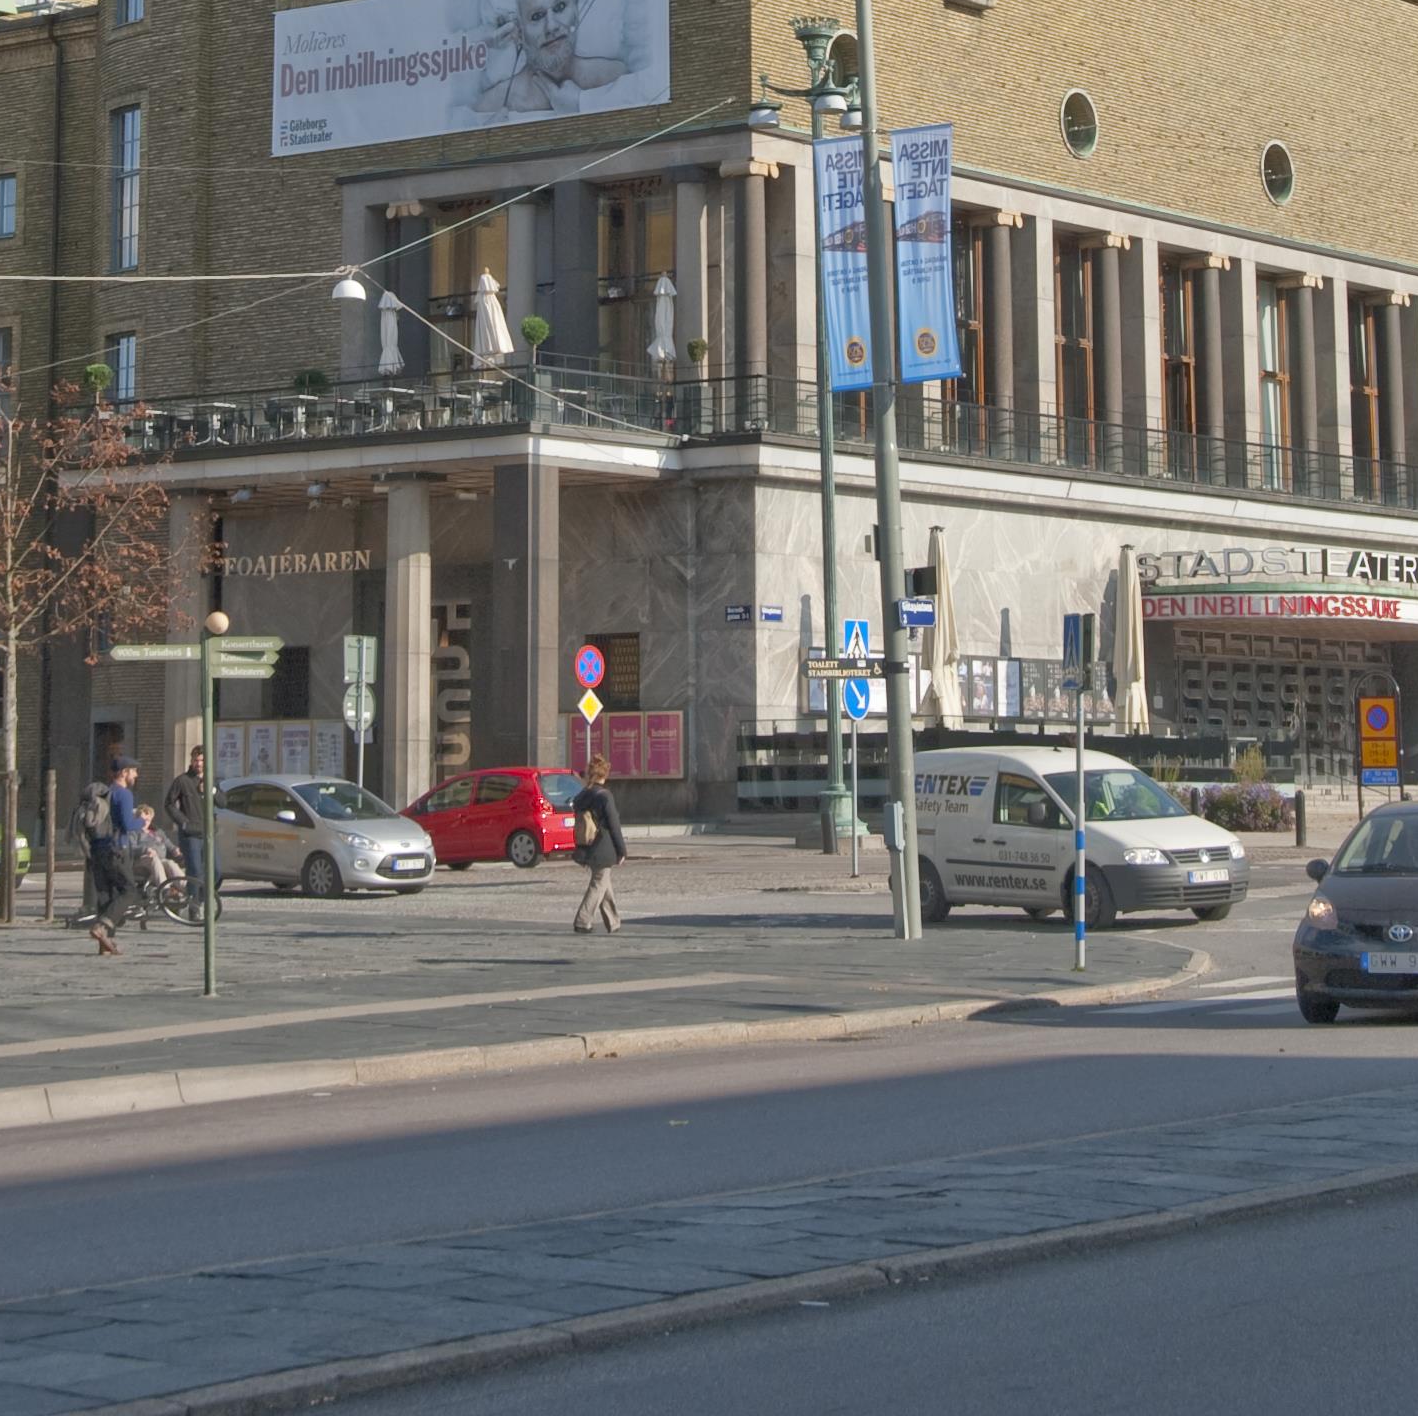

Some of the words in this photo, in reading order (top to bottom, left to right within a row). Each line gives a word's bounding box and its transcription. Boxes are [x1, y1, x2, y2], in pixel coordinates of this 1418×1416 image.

[283, 31, 347, 56] Molières
[281, 63, 319, 98] Den
[325, 36, 487, 92] inbillningssjuke
[289, 118, 328, 132] Göteborgs
[289, 131, 333, 146] Stadsteater
[223, 546, 372, 581] FOAJÉBAREN
[1142, 597, 1186, 618] DEN
[1194, 593, 1401, 620] INBILLNINGSSJUKE
[807, 661, 839, 669] TOALETT
[915, 774, 972, 796] ENTEX
[945, 800, 969, 814] Team
[955, 873, 1047, 891] www.rentex.se
[1371, 955, 1397, 968] GWW
